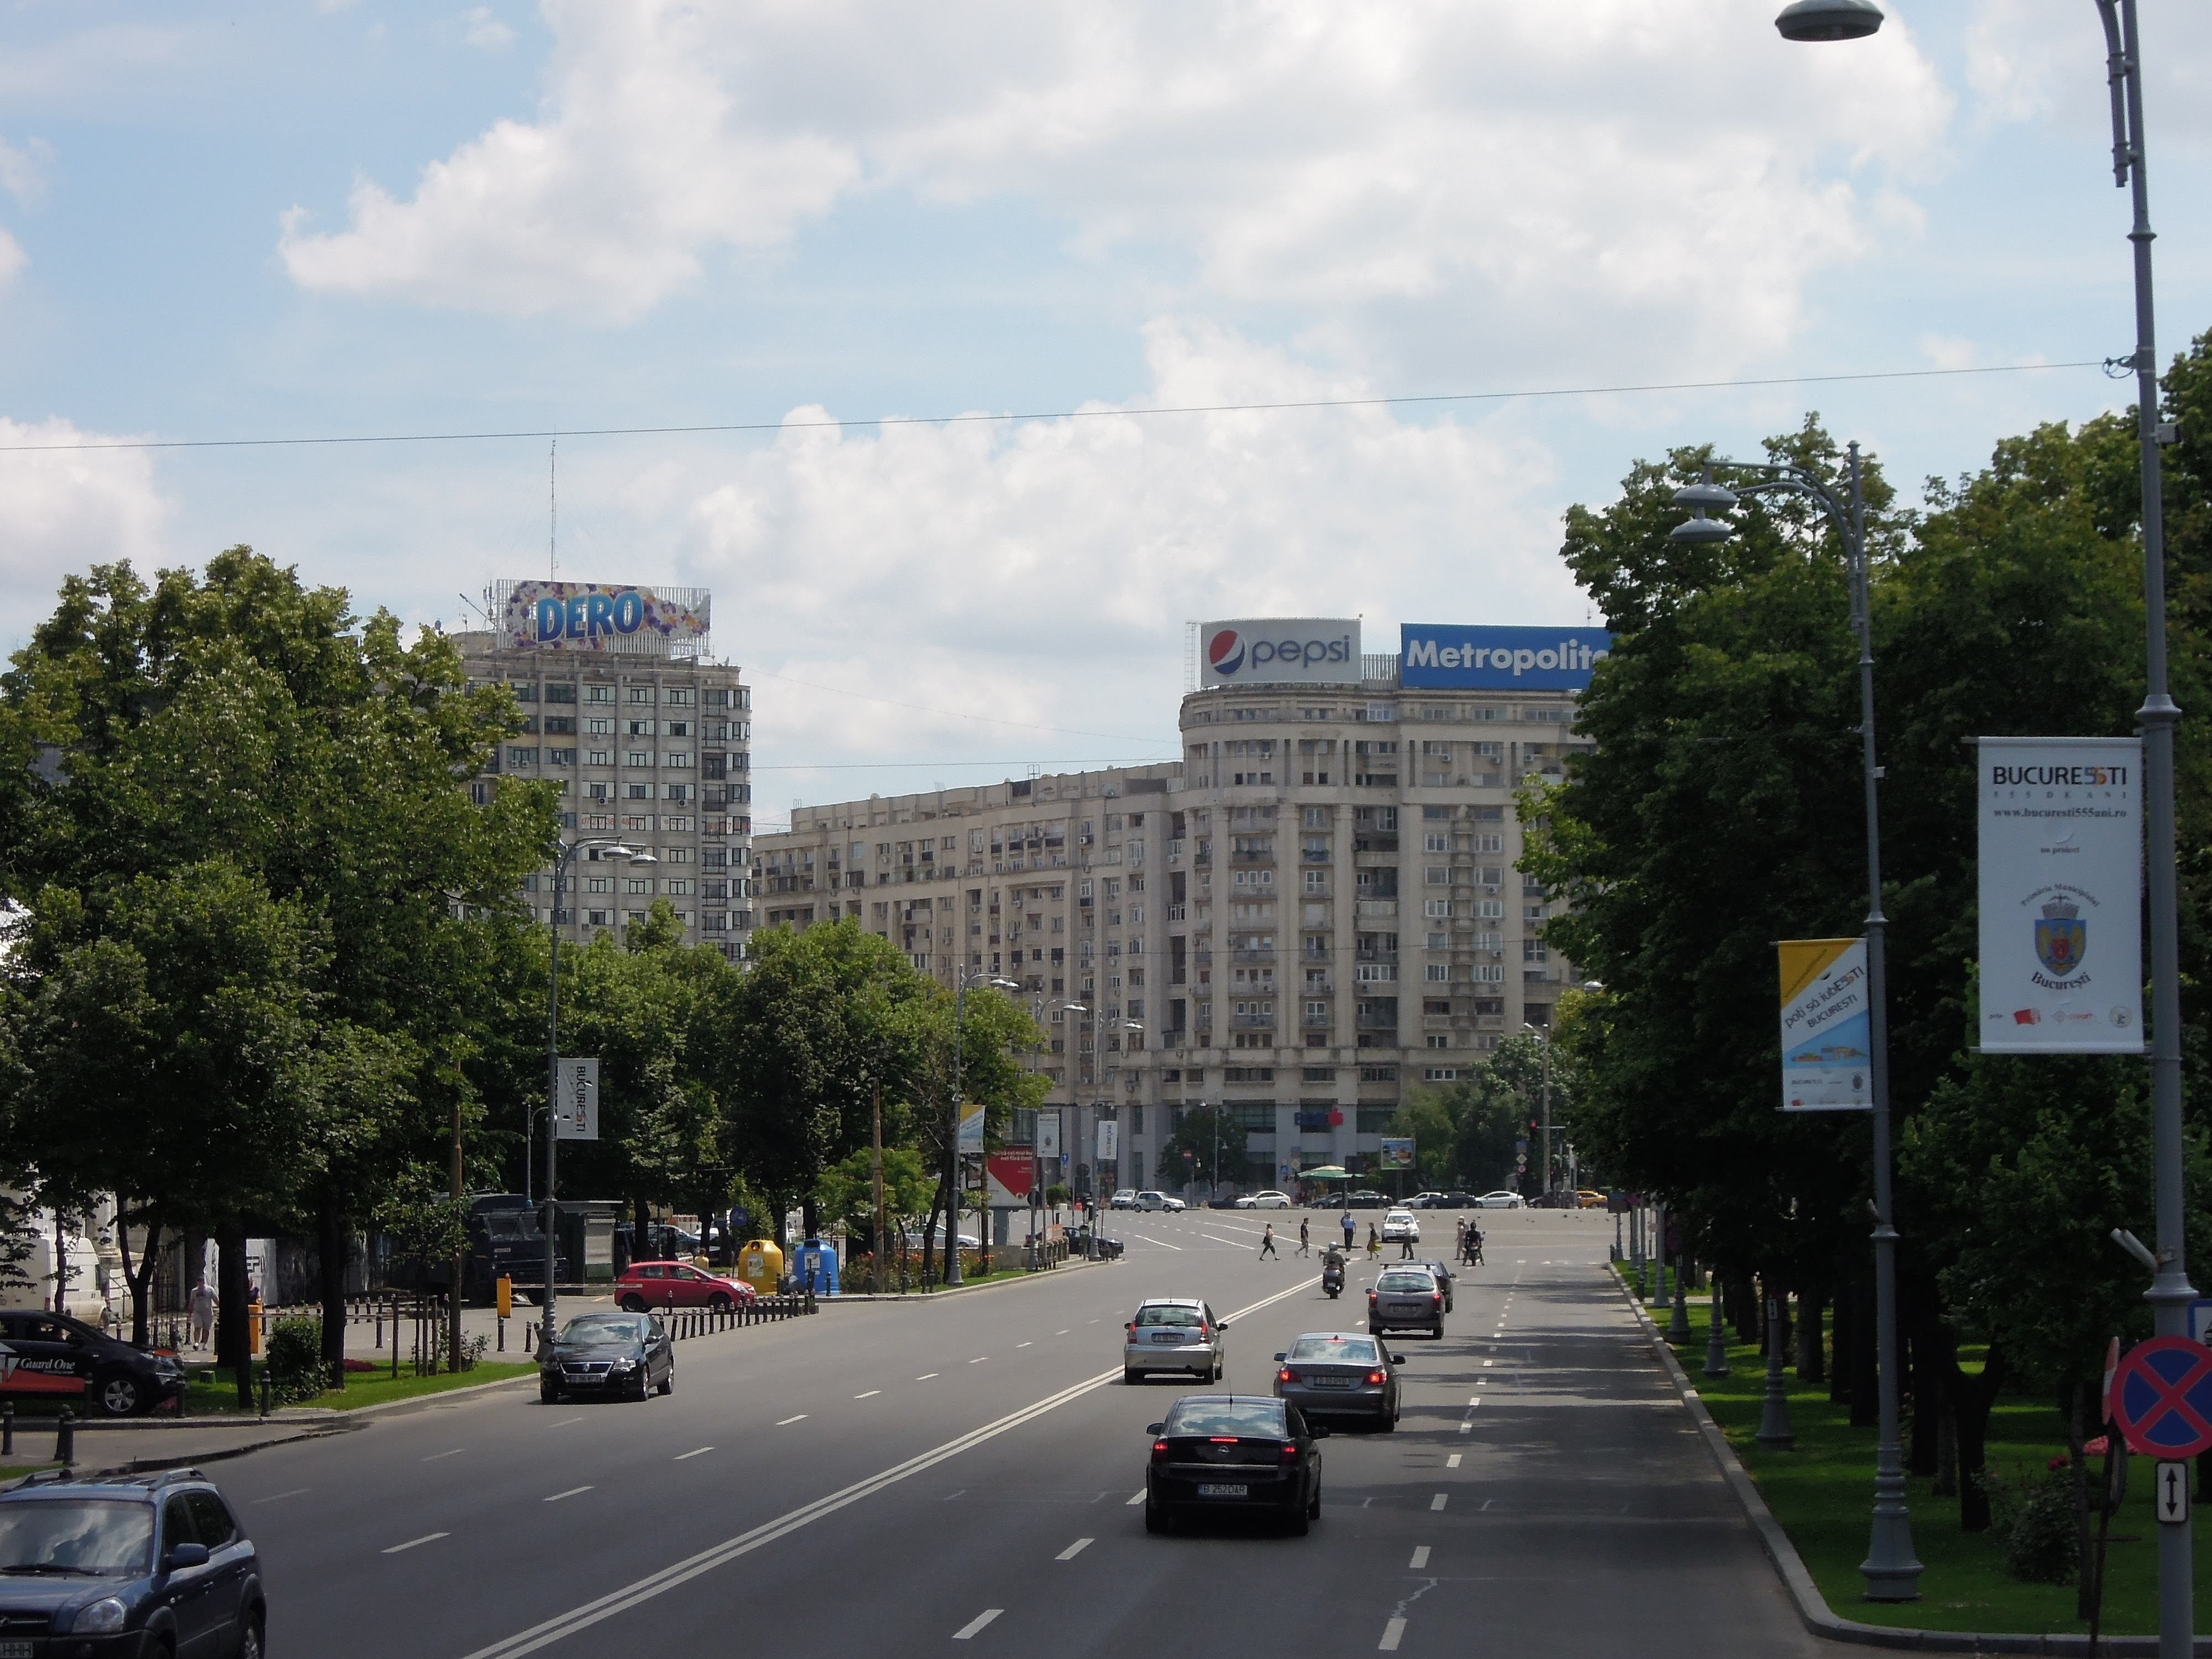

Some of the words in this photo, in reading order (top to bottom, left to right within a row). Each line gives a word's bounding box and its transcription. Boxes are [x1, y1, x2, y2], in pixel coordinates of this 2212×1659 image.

[537, 591, 644, 643] DERO
[1251, 634, 1350, 669] pepsi
[1994, 807, 2127, 818] www.bucuresti555ani.ro
[20, 1358, 54, 1369] Guard
[55, 1359, 75, 1370] One
